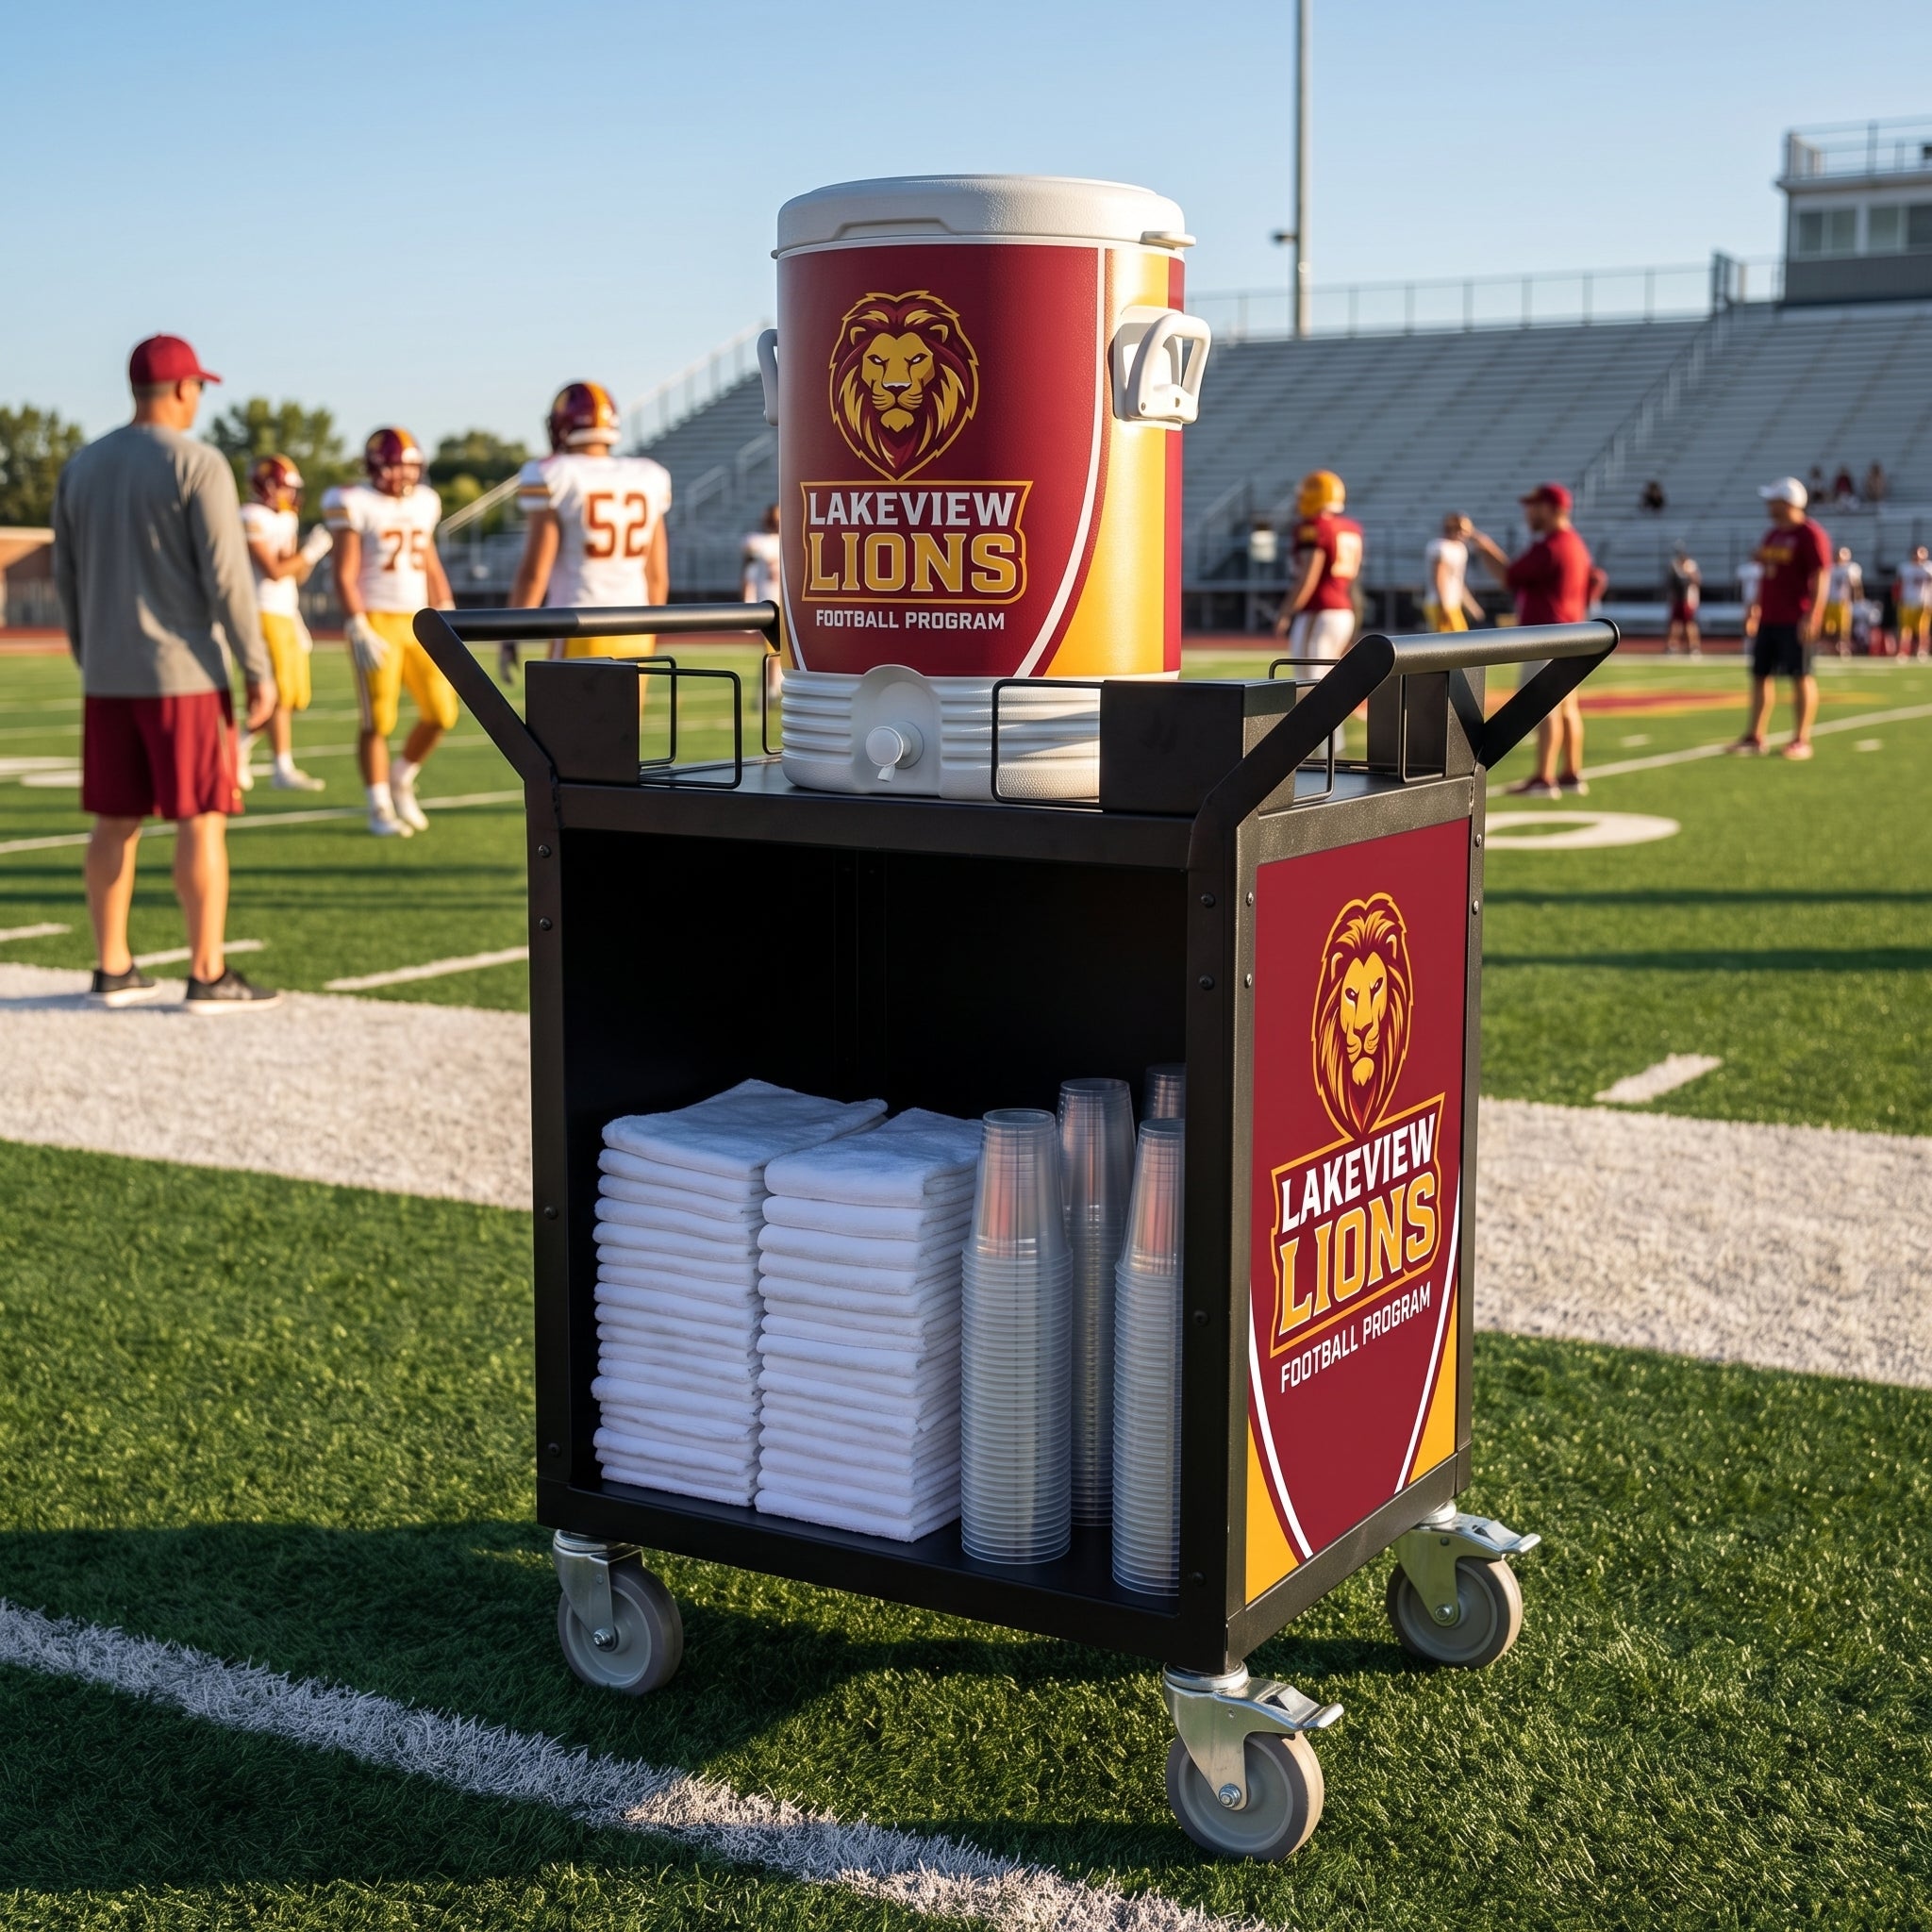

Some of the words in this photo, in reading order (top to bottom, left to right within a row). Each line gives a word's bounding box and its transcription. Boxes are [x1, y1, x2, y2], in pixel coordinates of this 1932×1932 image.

[585, 491, 649, 558] 52
[809, 491, 1016, 526] LAKEVIEW
[808, 532, 1017, 593] LIONS
[816, 609, 899, 629] FOOTBALL
[905, 611, 1005, 630] PROGRAM
[1281, 1112, 1436, 1234] LAKEVIEW
[1278, 1171, 1435, 1337] LIONS
[1280, 1324, 1358, 1393] FOOTBALL
[1362, 1281, 1431, 1346] PROGRAM
